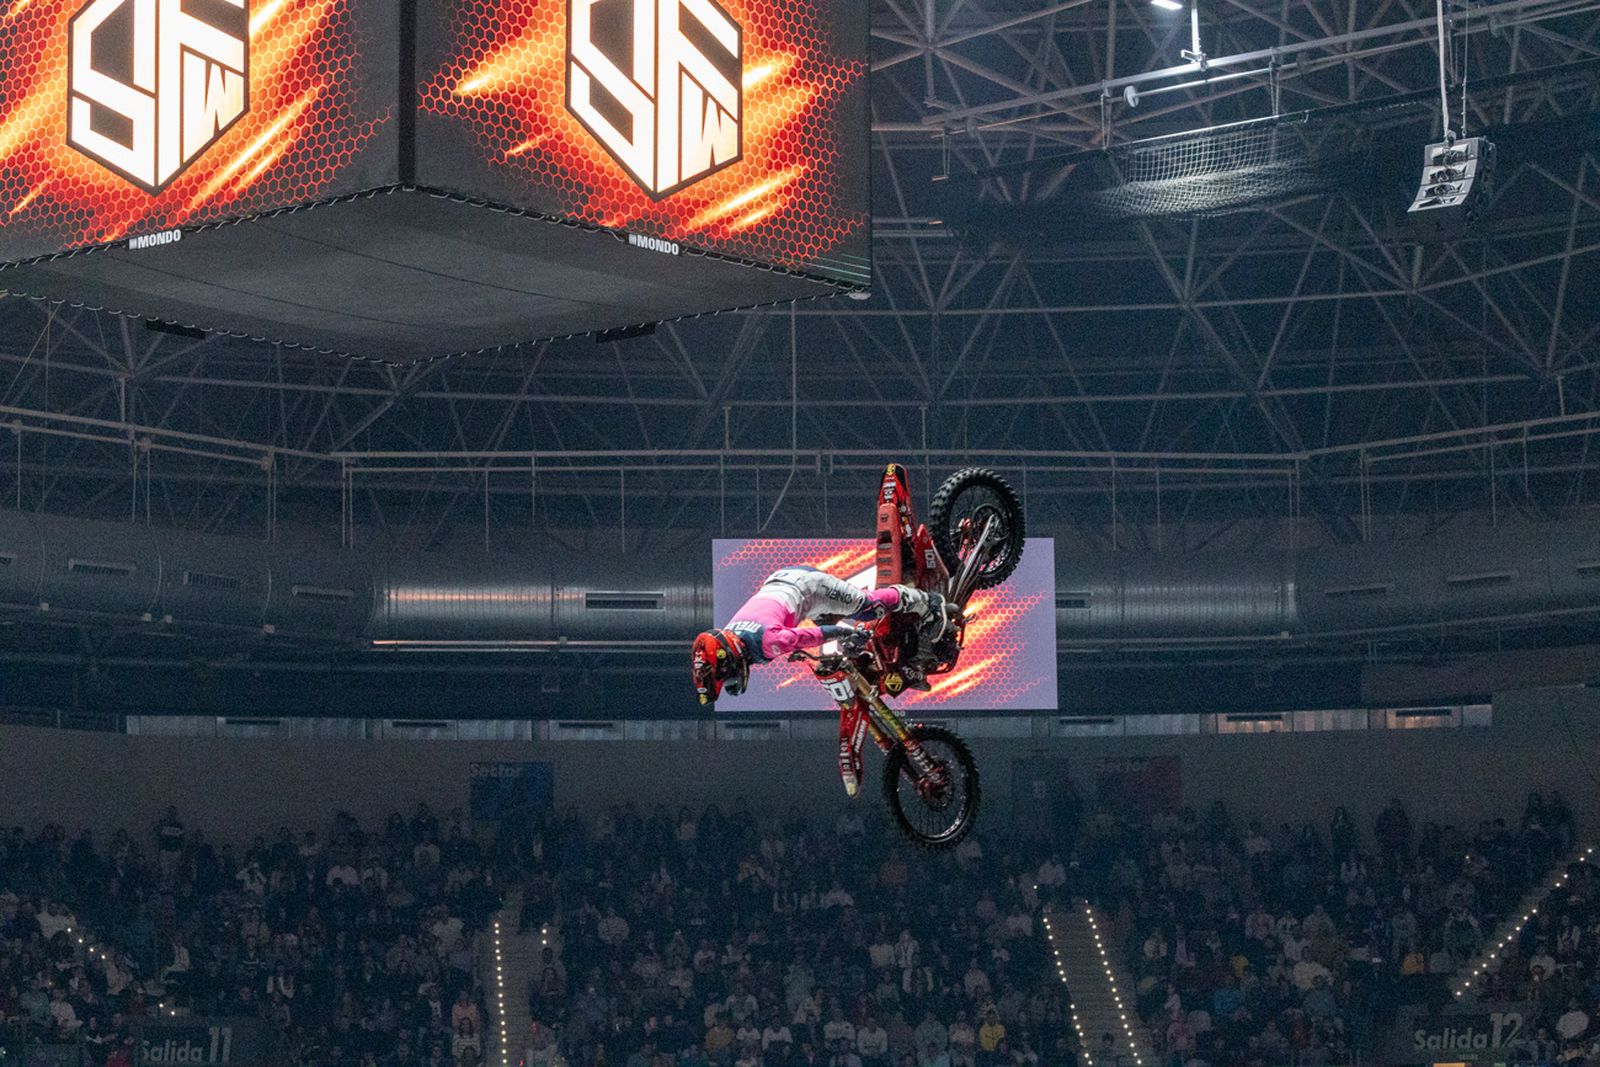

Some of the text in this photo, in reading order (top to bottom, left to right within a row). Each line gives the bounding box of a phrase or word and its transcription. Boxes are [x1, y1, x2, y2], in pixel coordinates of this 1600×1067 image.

[137, 229, 182, 249] MONDO
[637, 234, 680, 256] MONDO
[470, 763, 522, 778] Sector
[1414, 1012, 1525, 1050] Salida 12
[208, 1026, 232, 1063] 11
